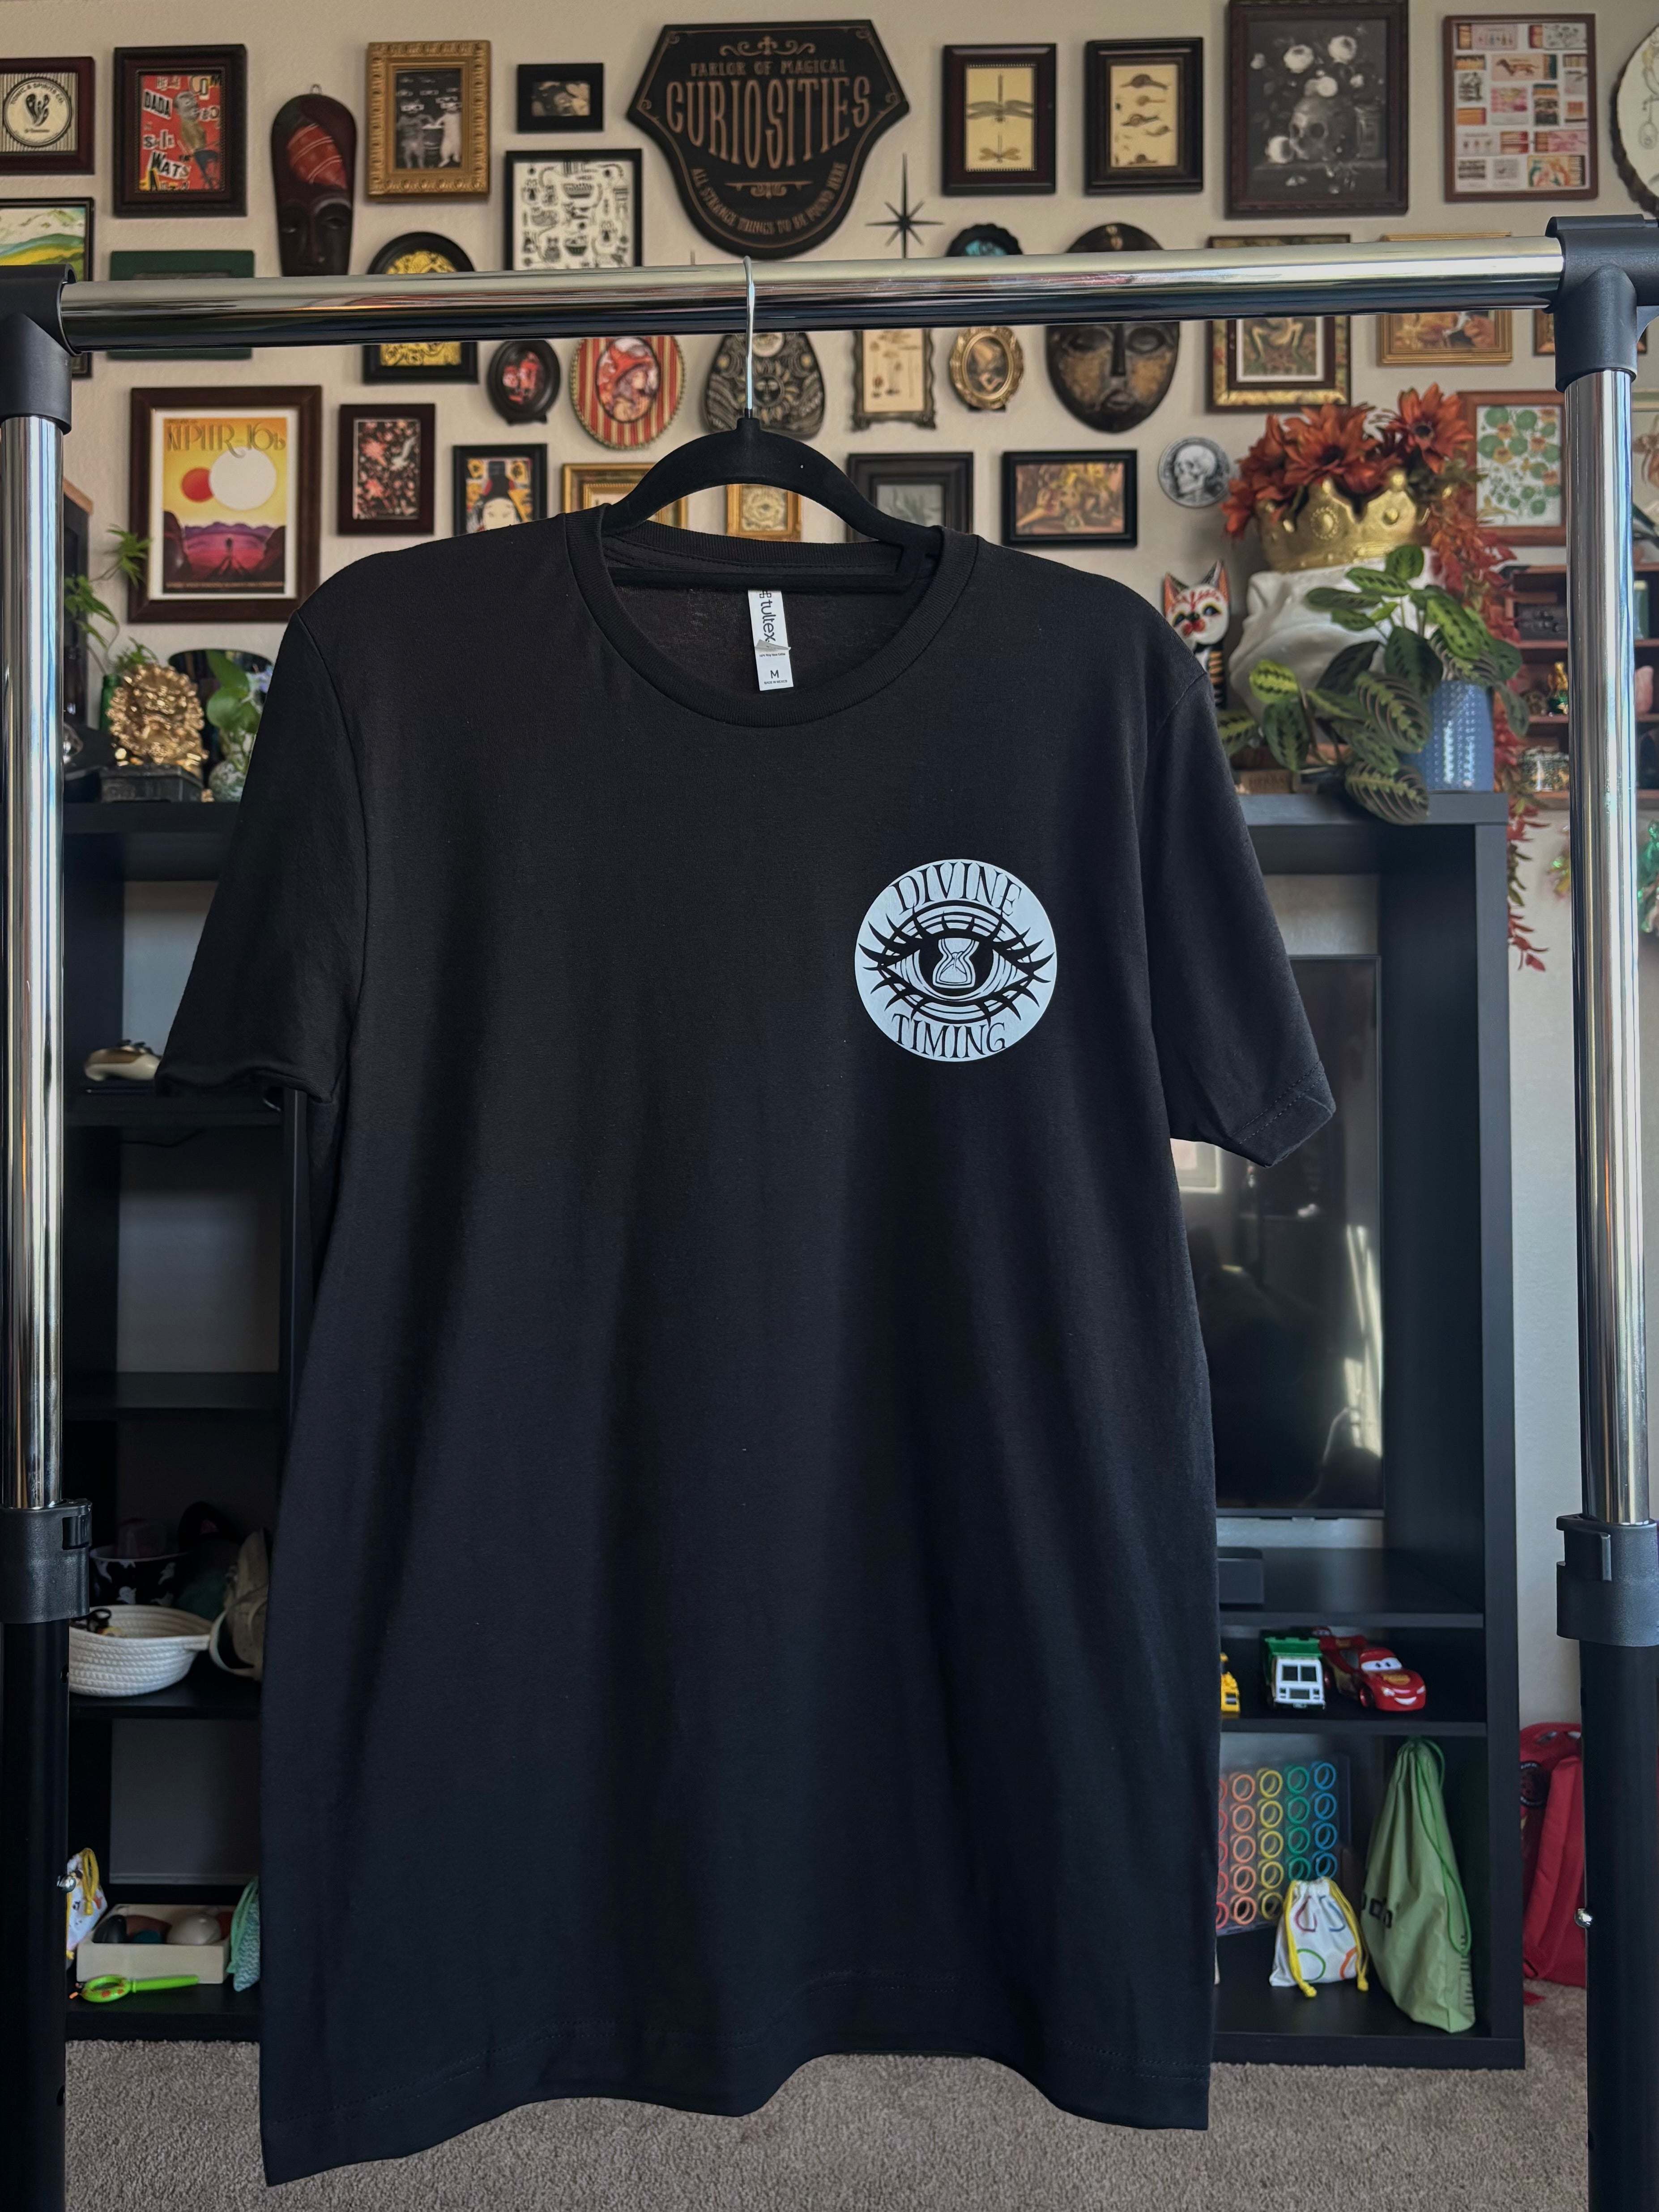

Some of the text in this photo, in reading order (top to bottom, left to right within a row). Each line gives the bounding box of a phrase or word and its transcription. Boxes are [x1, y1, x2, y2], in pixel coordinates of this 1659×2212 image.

[691, 59, 847, 77] PARLOR OF MAGICAL
[145, 91, 170, 115] DADA
[666, 76, 870, 170] CURIOSITIES
[770, 669, 779, 679] M
[888, 861, 1022, 916] DIVINE
[891, 1013, 1006, 1058] TIMING
